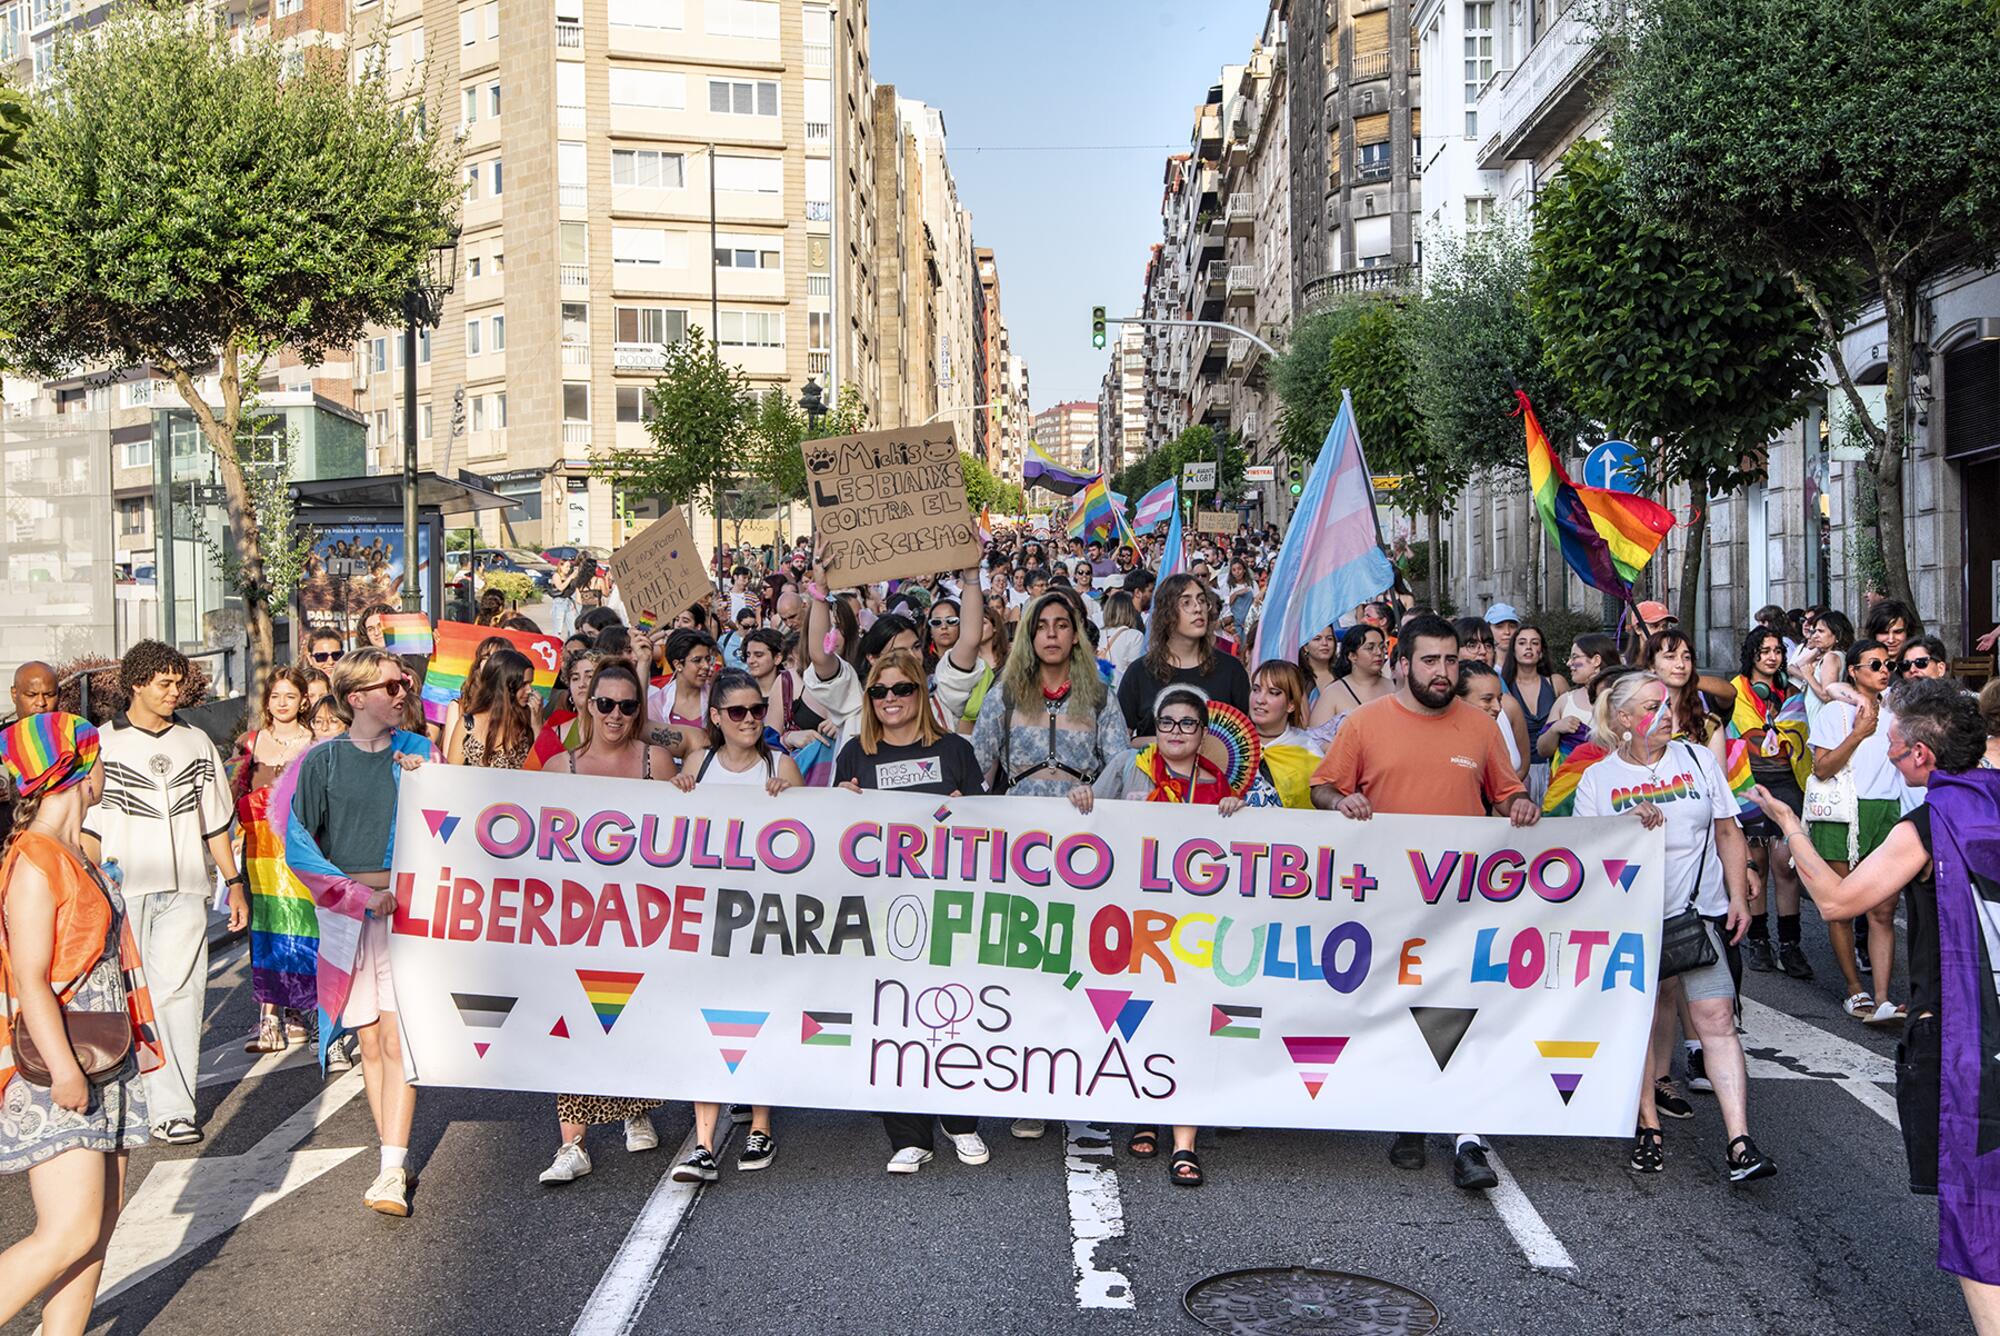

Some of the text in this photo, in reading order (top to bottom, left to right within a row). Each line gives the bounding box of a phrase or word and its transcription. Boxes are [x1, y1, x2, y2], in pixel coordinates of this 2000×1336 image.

[619, 355, 667, 365] PODOLO
[839, 440, 921, 475] Michis
[814, 461, 964, 508] LESBIANXS
[821, 490, 961, 534] CONTRA EL
[830, 524, 971, 569] FASCISMO
[630, 567, 676, 614] COMER
[647, 582, 690, 621] TODO
[1236, 736, 1250, 762] STOP
[1611, 775, 1687, 813] ORGULLO
[475, 801, 1585, 905] ORGULLO CRÍTICO LGTBI+ VIGO
[711, 888, 876, 957] PARA
[886, 894, 926, 961] O
[1089, 903, 1373, 994] ORGULLO
[1398, 937, 1426, 986] E
[1471, 926, 1645, 994] LOITA
